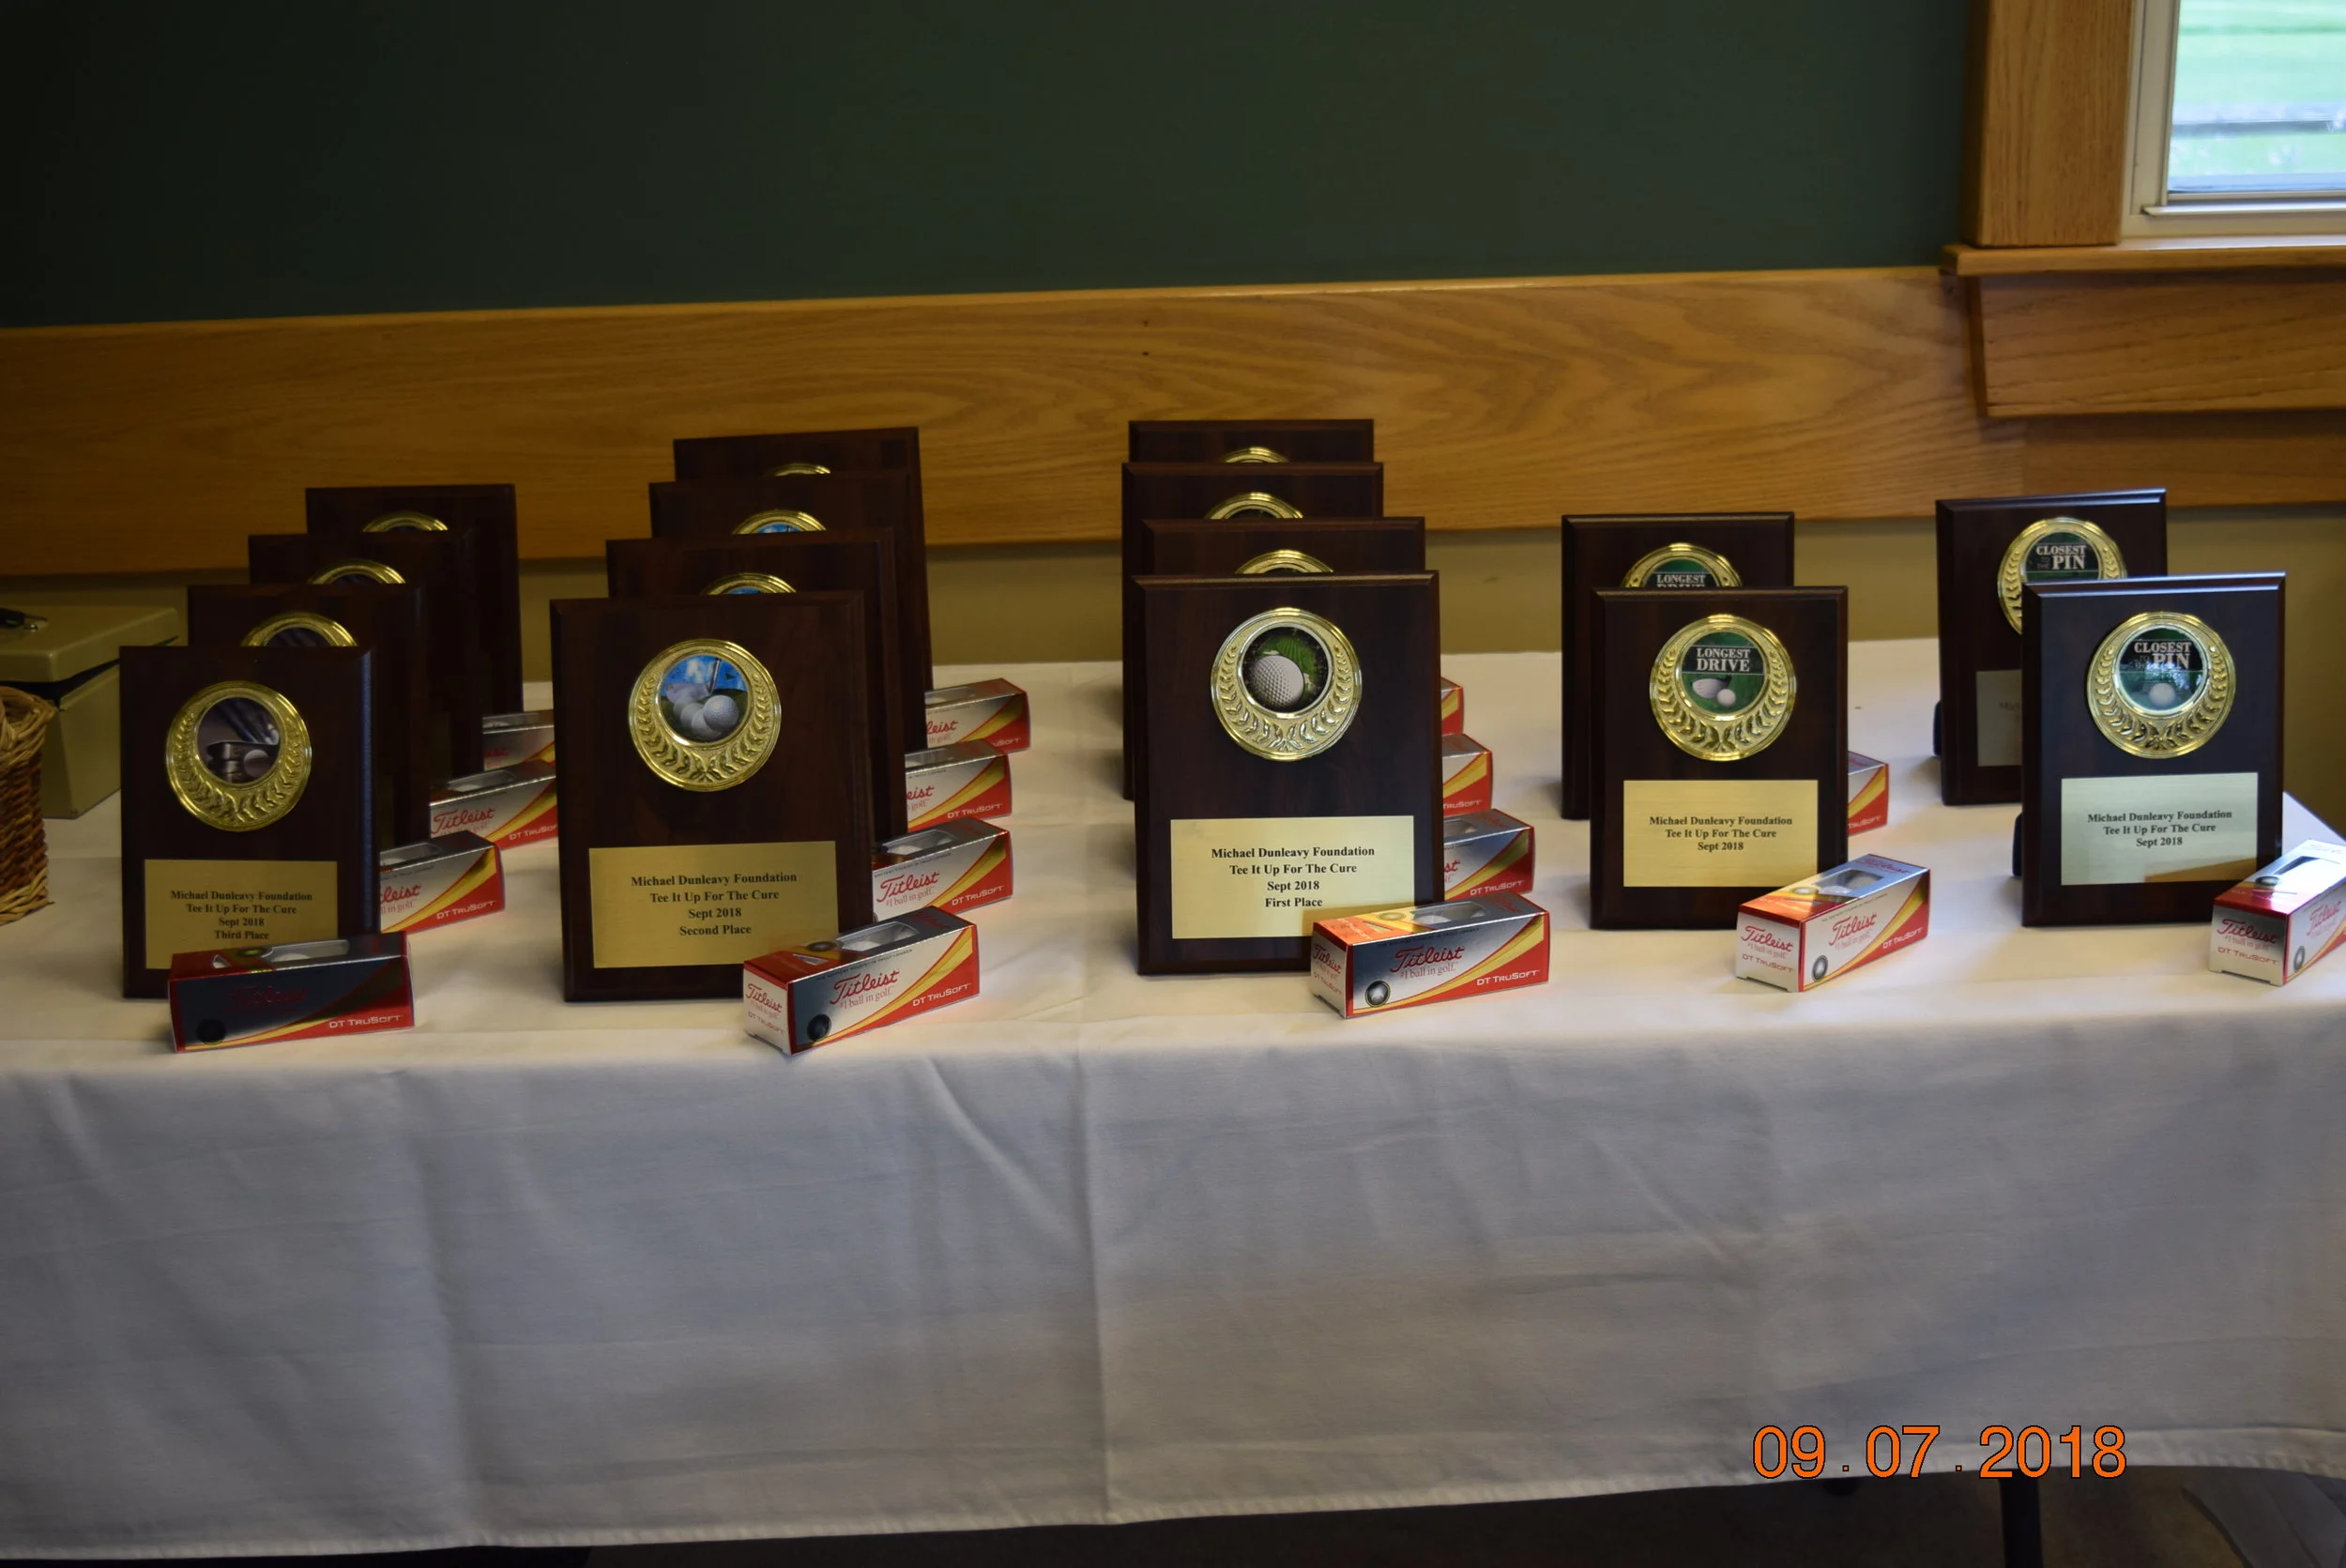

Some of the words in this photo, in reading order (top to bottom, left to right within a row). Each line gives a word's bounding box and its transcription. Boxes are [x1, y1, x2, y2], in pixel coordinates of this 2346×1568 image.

[2035, 544, 2087, 556] CLOSEST
[2051, 555, 2085, 571] PIN
[1656, 574, 1706, 584] LONGEST
[1697, 647, 1751, 659] LONGEST
[2134, 642, 2192, 653] CLOSEST
[1697, 658, 1750, 672] DRIVE
[2151, 653, 2191, 669] PIN
[927, 721, 958, 735] leist
[906, 785, 935, 800] eist
[947, 810, 960, 819] DT
[2087, 813, 2126, 823] Michael
[2128, 812, 2174, 822] Dunleavy
[2176, 810, 2232, 820] Foundation
[431, 808, 495, 834] Titleist
[1649, 816, 1688, 826] Michael
[1690, 816, 1735, 828] Dunleavy
[1738, 816, 1792, 826] Foundation
[1665, 829, 1682, 838] Tee
[1683, 829, 1693, 838] It
[1695, 829, 1710, 840] Up
[1712, 829, 1729, 838] For
[1731, 829, 1750, 838] The
[1752, 829, 1776, 838] Cure
[2103, 826, 2121, 835] Tee
[2123, 826, 2132, 835] It
[2133, 825, 2148, 836] Up
[2150, 824, 2169, 833] For
[2171, 824, 2190, 833] The
[2191, 823, 2217, 832] Cure
[1698, 842, 1719, 852] Sept
[1721, 842, 1744, 851] 2018
[2136, 837, 2158, 848] Sept
[2159, 836, 2183, 846] 2018
[1211, 848, 1255, 859] Michael
[1258, 847, 1310, 859] Dunleavy
[1312, 846, 1376, 857] Foundation
[1228, 864, 1248, 875] Tee
[1251, 864, 1260, 875] It
[1264, 864, 1280, 876] Up
[1283, 864, 1303, 874] For
[1305, 863, 1327, 874] The
[1330, 863, 1357, 873] Cure
[631, 875, 676, 887] Michael
[678, 874, 731, 887] Dunleavy
[734, 872, 797, 884] Foundation
[876, 871, 940, 903] Titleist
[1267, 881, 1291, 892] Sept
[1294, 880, 1319, 891] 2018
[1470, 887, 1483, 896] DT
[171, 891, 208, 900] Michael
[211, 891, 254, 903] Dunleavy
[258, 891, 312, 901] Foundation
[380, 884, 421, 903] leist
[649, 892, 669, 904] Tee
[672, 892, 681, 903] It
[684, 891, 701, 905] Up
[704, 891, 724, 902] For
[726, 890, 749, 901] The
[752, 890, 780, 900] Cure
[893, 895, 907, 906] ball
[909, 893, 917, 902] in
[952, 897, 964, 906] DT
[1265, 898, 1291, 907] First
[1294, 897, 1323, 907] Place
[186, 904, 203, 913] Tee
[206, 904, 213, 913] It
[217, 905, 230, 915] Up
[233, 905, 249, 913] For
[252, 905, 271, 914] The
[273, 905, 297, 914] Cure
[436, 910, 449, 920] DT
[688, 908, 713, 921] Sept
[716, 907, 742, 918] 2018
[219, 918, 239, 928] Sept
[242, 918, 265, 926] 2018
[215, 930, 241, 939] Third
[245, 930, 269, 939] Place
[679, 925, 719, 936] Second
[723, 924, 752, 936] Place
[1829, 913, 1877, 946] Titleist
[2217, 919, 2278, 943] Titleist
[1741, 925, 1793, 951] Titleist
[1882, 939, 1893, 949] DT
[1389, 945, 1465, 973] Titleist
[1400, 970, 1409, 980] #1
[1409, 967, 1425, 979] ball
[1427, 966, 1436, 975] in
[830, 969, 900, 1005] Titleist
[1476, 977, 1490, 986] DT
[848, 995, 864, 1008] ball
[865, 993, 874, 1003] in
[912, 996, 927, 1007] DT
[328, 1019, 345, 1029] DT
